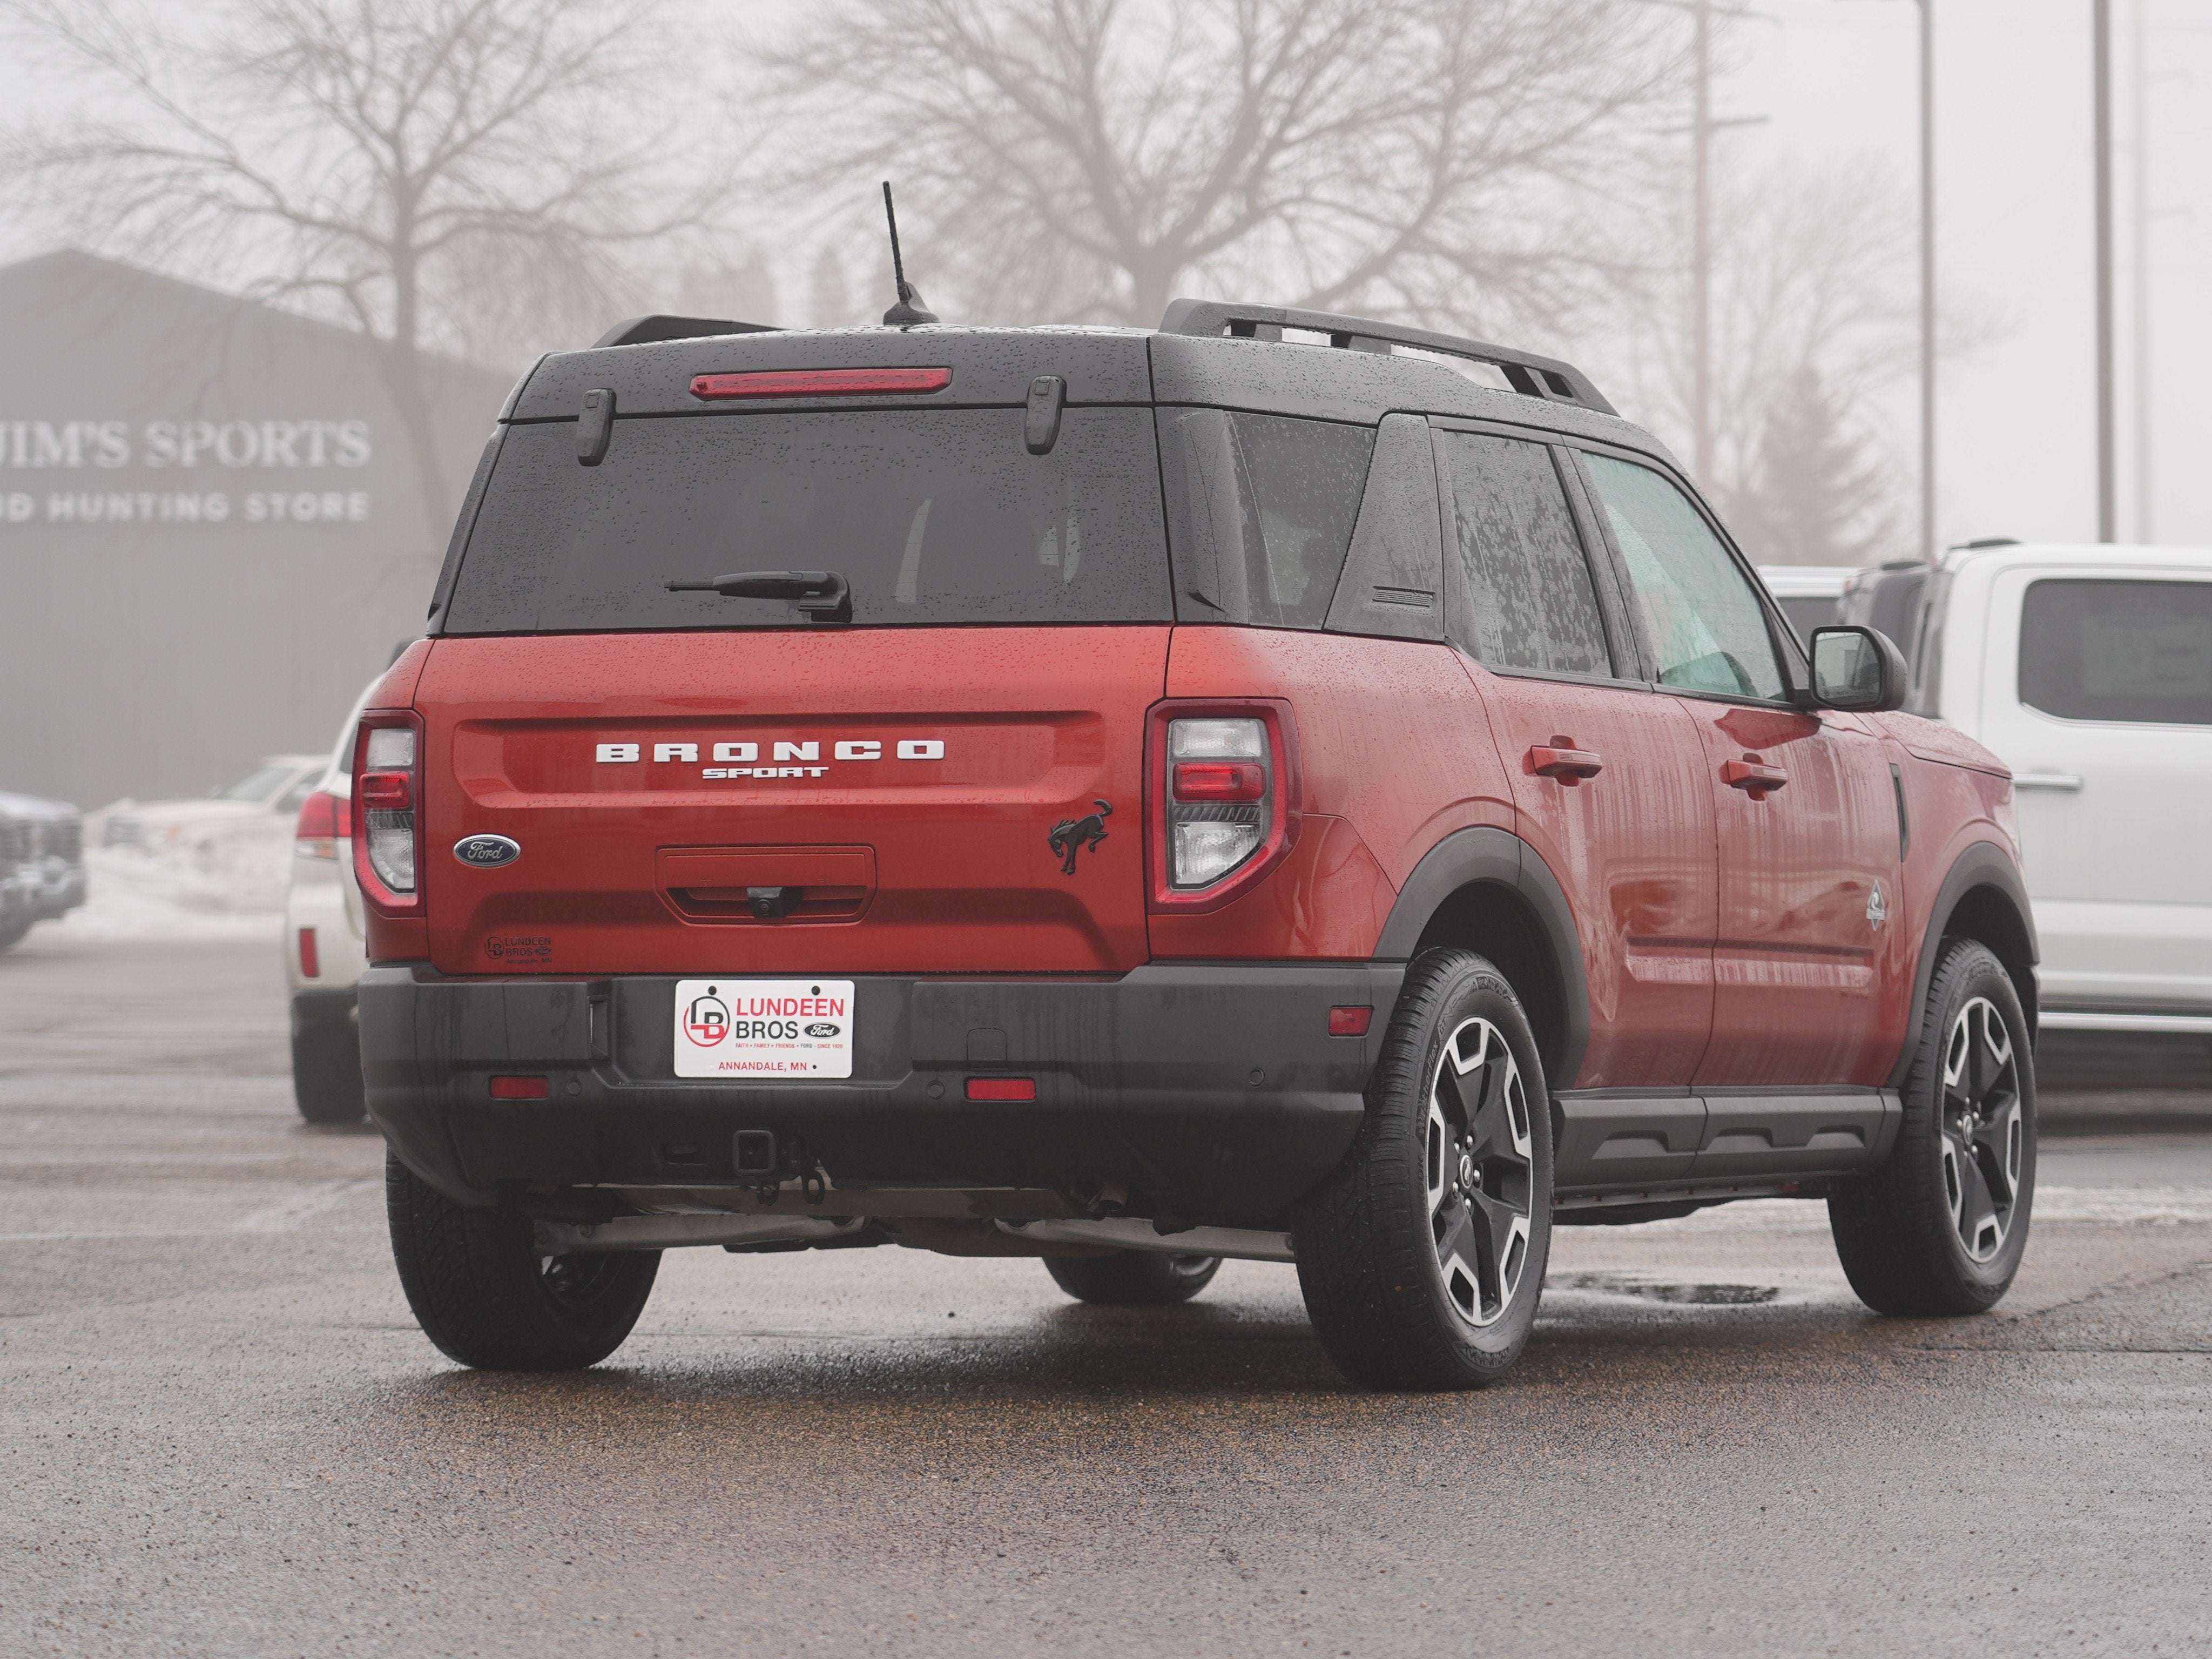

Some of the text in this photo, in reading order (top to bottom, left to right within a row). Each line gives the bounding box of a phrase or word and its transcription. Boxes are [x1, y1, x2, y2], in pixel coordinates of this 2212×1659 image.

[144, 420, 372, 468] SPORTS
[0, 491, 369, 523] D HUNTING STORE
[596, 740, 945, 763] BRONCO
[702, 766, 830, 779] SPORT
[467, 841, 504, 860] Ford
[505, 937, 551, 946] LUNDEEN
[505, 947, 533, 956] BROS
[737, 998, 844, 1016] LUNDEEN
[736, 1021, 834, 1039] BROS Ford
[718, 1062, 807, 1071] ANNANDALE, MN
